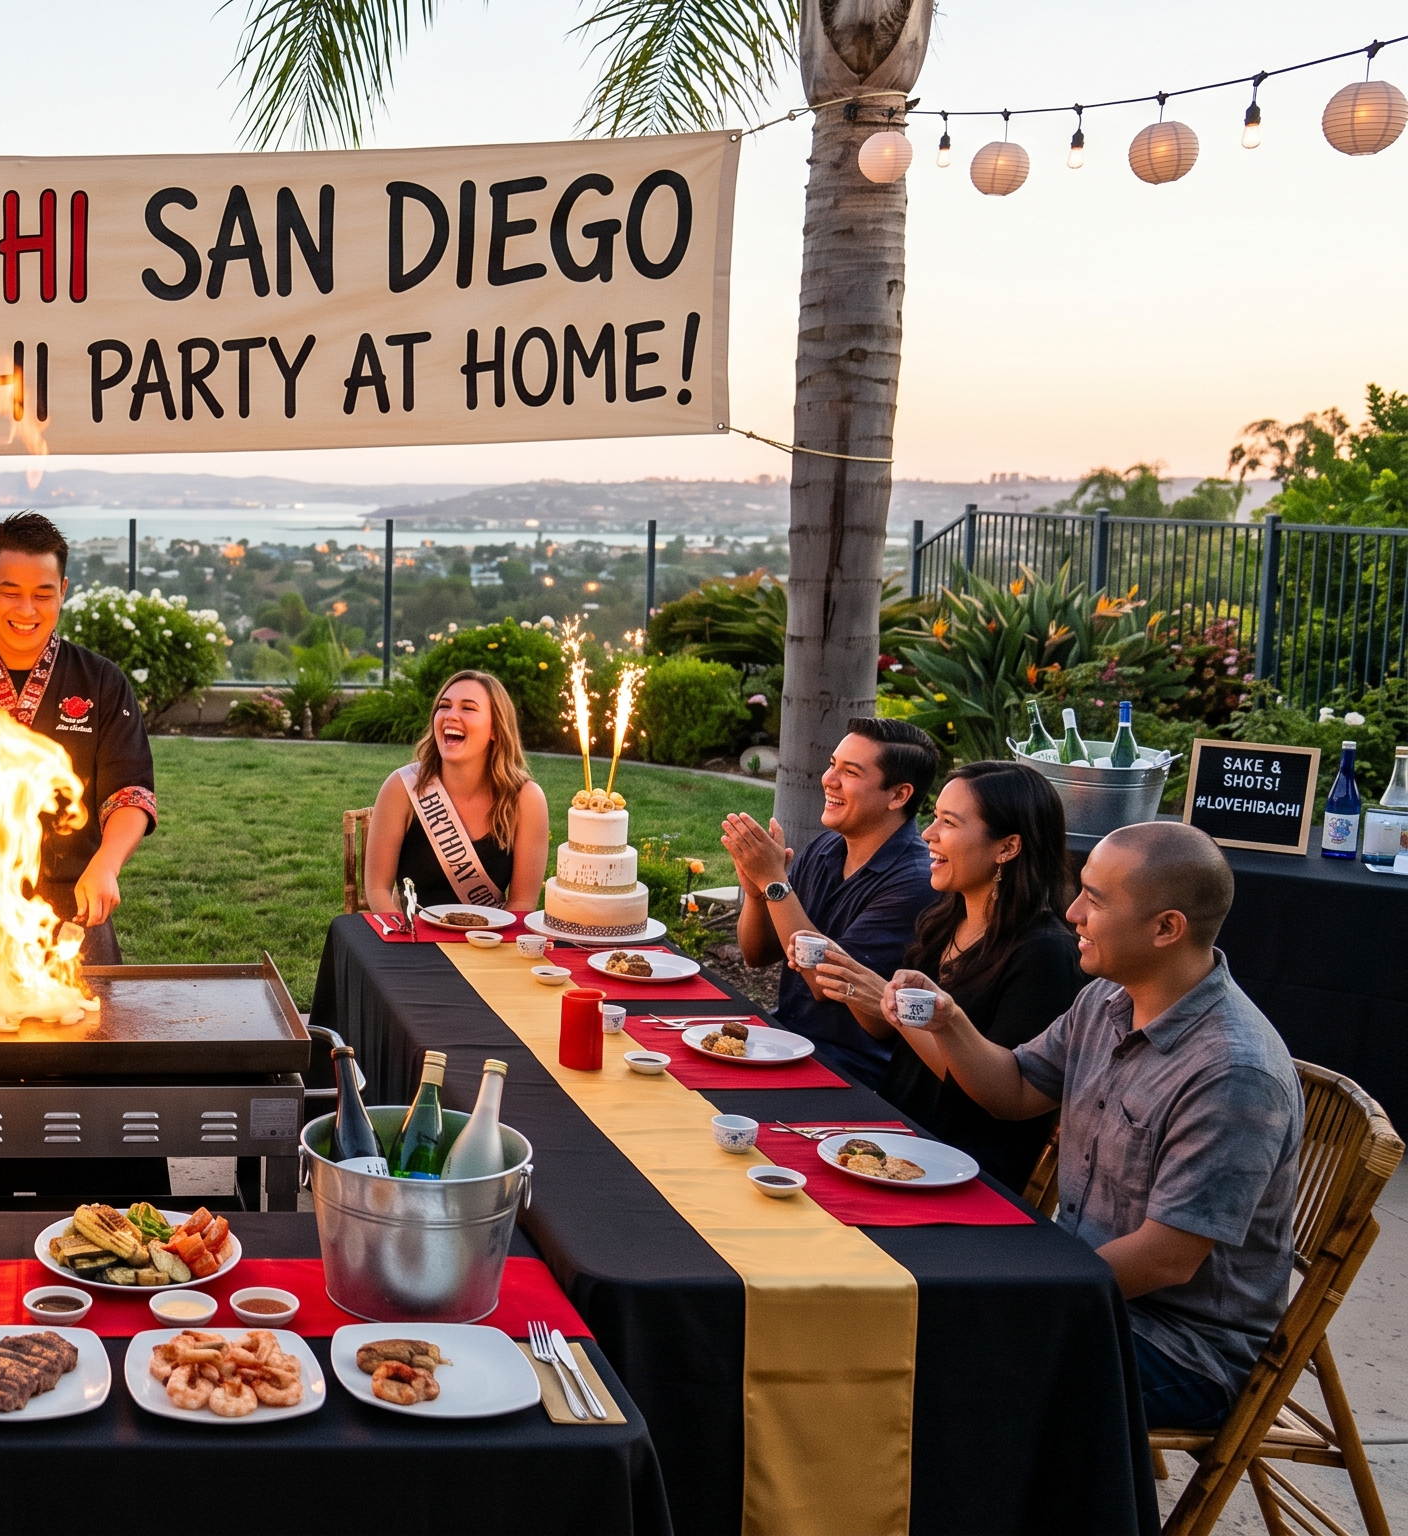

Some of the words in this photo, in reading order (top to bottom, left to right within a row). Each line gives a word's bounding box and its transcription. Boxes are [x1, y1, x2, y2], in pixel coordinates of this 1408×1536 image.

[141, 183, 335, 301] SAN
[385, 169, 693, 294] DIEGO
[87, 334, 317, 424] PARTY
[342, 331, 432, 415] AT
[460, 311, 701, 411] HOME!
[1222, 756, 1264, 773] SAKE
[1270, 760, 1282, 774] &
[1223, 773, 1281, 791] SHOTS!
[1195, 795, 1301, 818] #LOVEHIBACHI
[418, 791, 480, 884] BIRTHDAY
